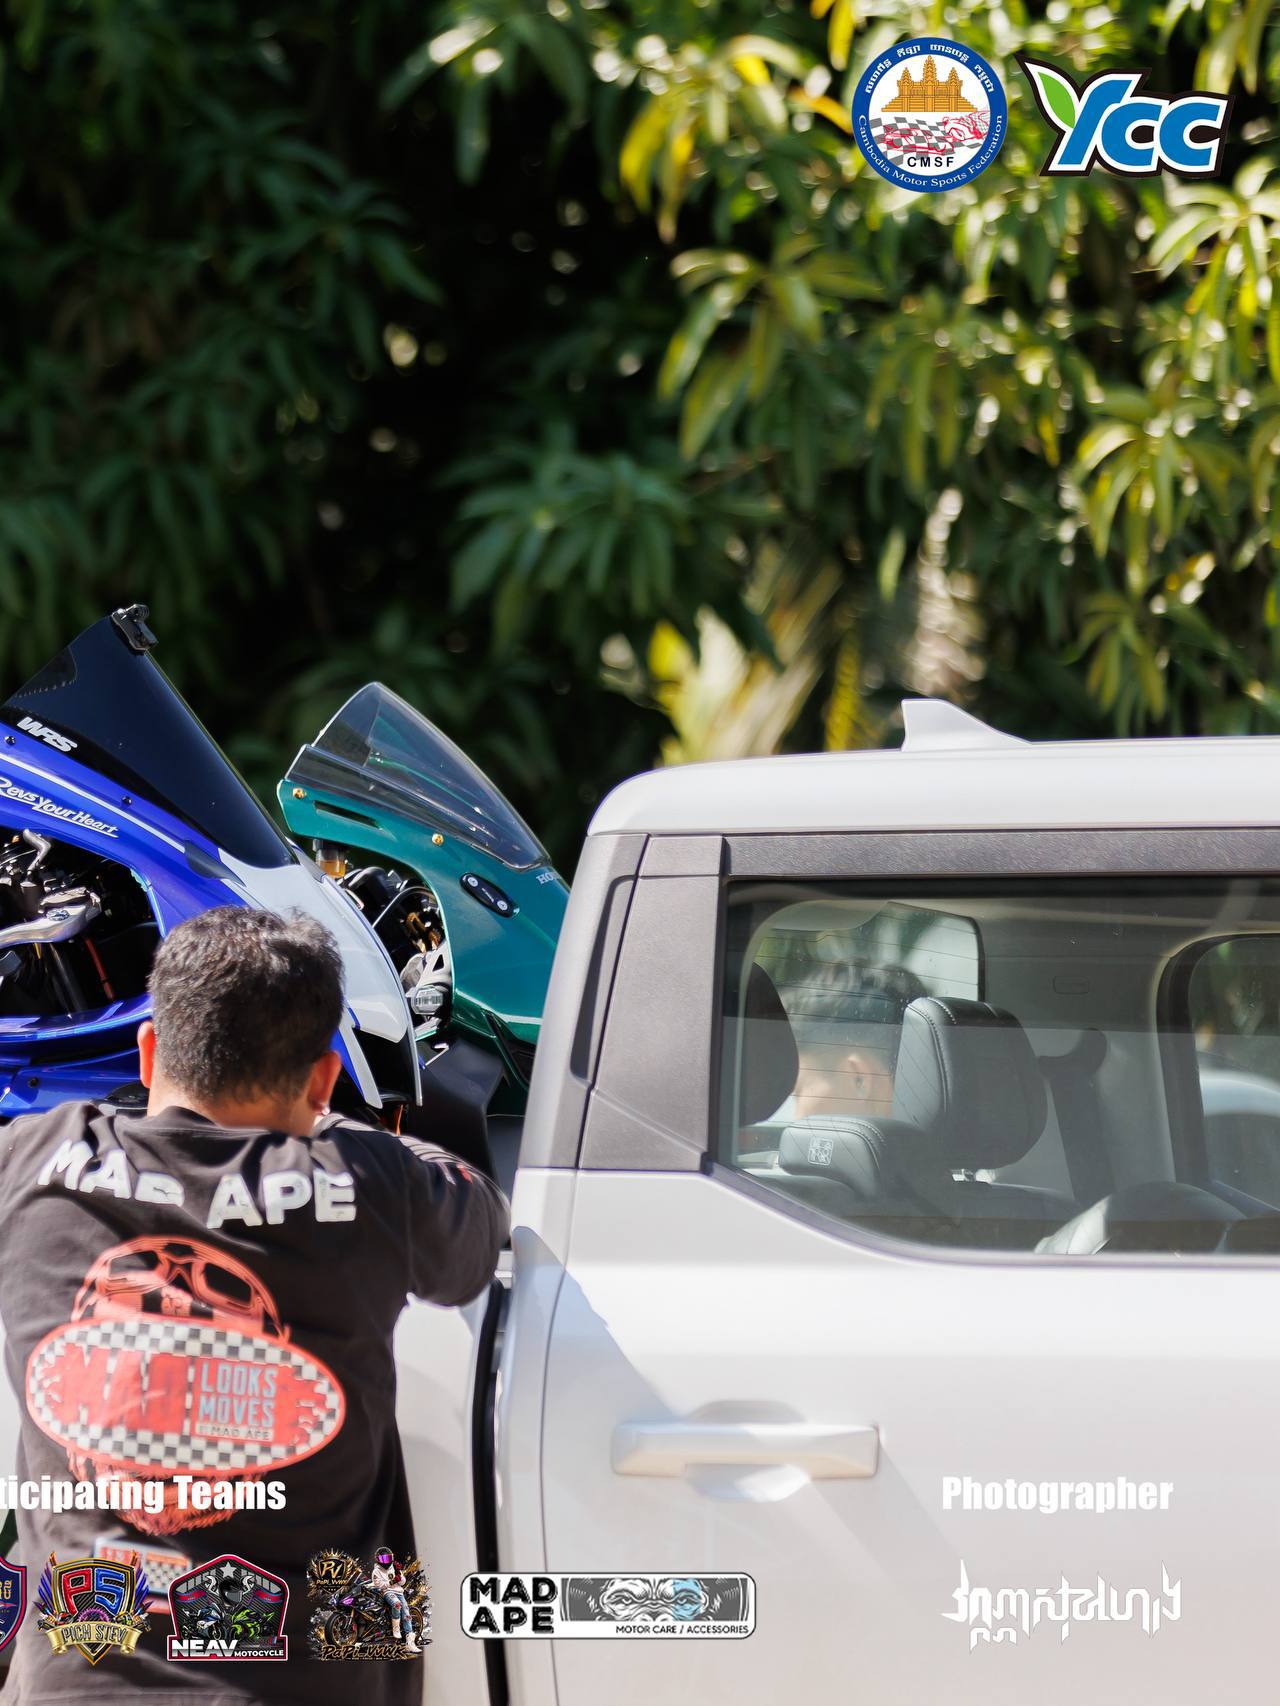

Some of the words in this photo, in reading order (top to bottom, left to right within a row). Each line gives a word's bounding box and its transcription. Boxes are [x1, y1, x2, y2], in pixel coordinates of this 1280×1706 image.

[17, 716, 78, 752] WRS
[37, 1138, 185, 1207] MAD
[206, 1168, 357, 1229] APE
[201, 1361, 278, 1398] LOOKS
[198, 1393, 276, 1428] MOVES
